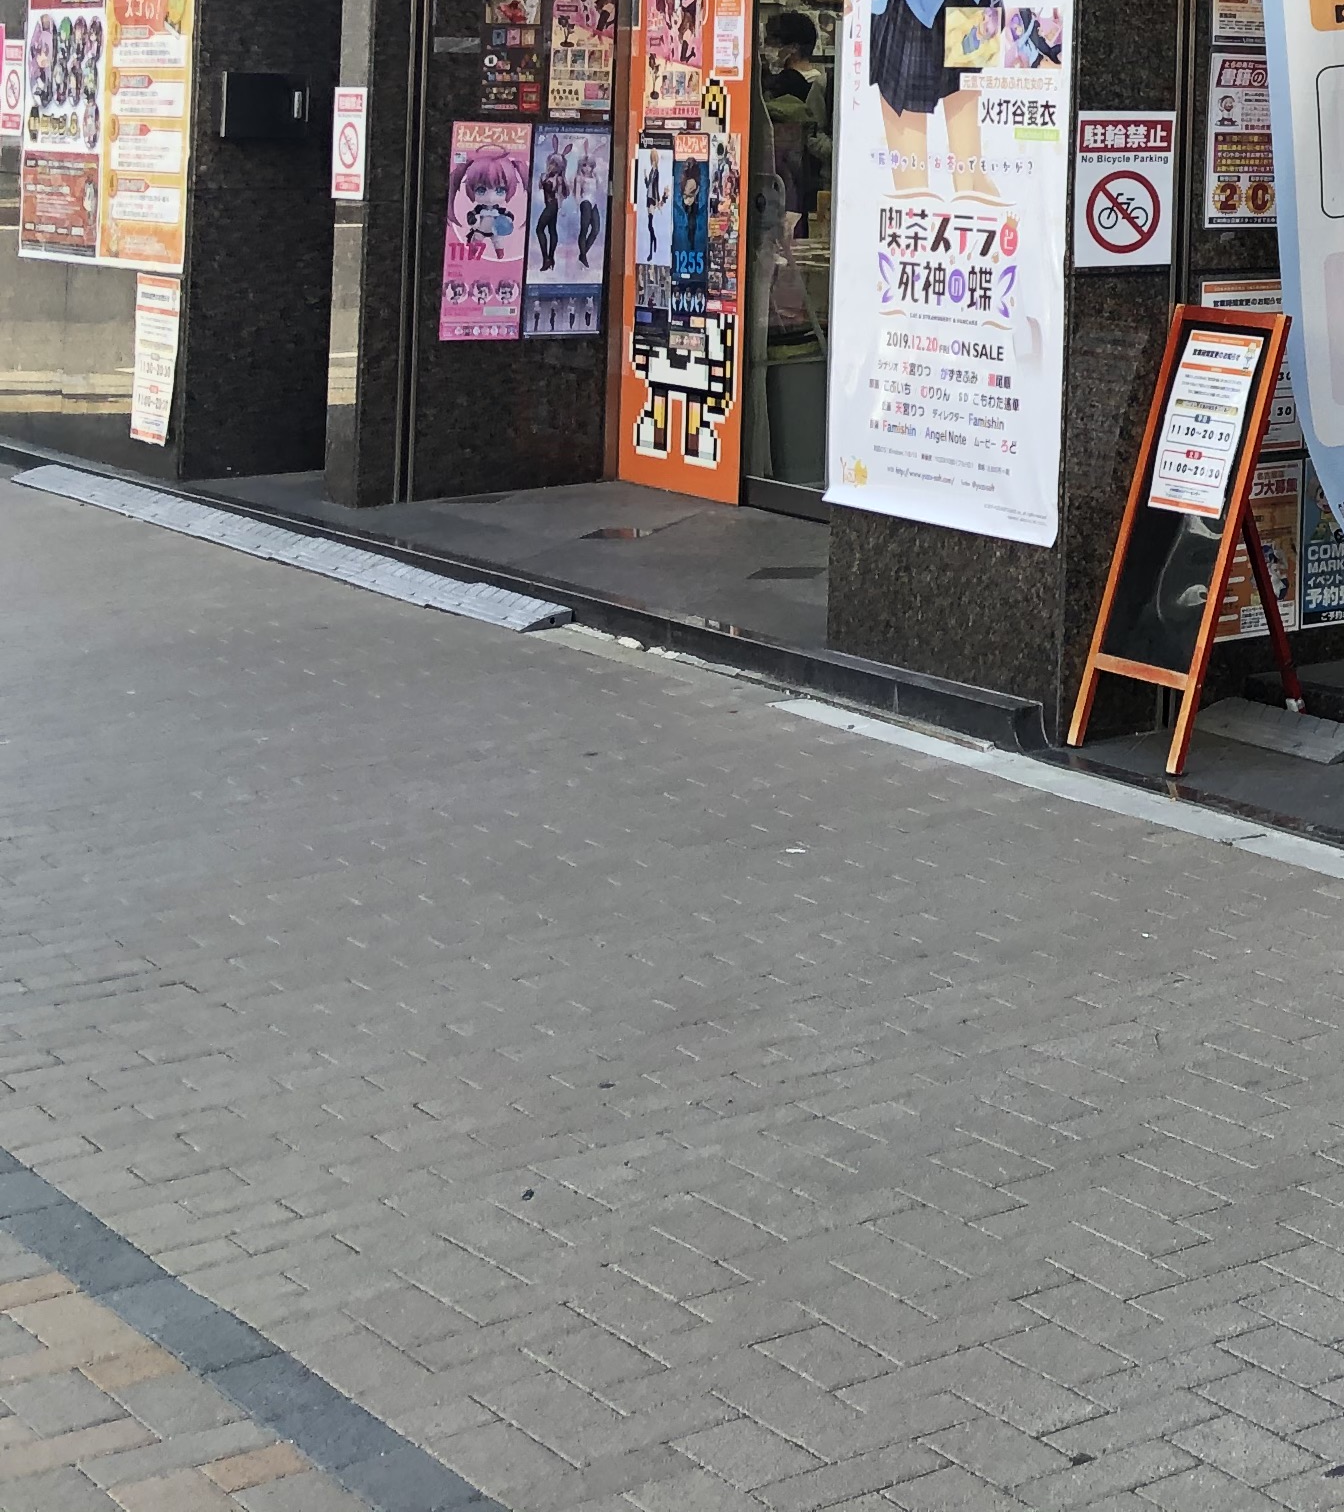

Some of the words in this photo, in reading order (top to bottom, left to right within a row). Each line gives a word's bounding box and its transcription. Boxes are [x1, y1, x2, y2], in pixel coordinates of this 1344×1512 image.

[981, 98, 1057, 127] 火打谷愛衣
[457, 125, 527, 145] ねんどろいど
[1082, 124, 1169, 149] 駐輪禁止
[1081, 155, 1094, 164] No
[1096, 154, 1131, 165] Bicycle
[1133, 154, 1169, 165] Parking
[879, 206, 1020, 257] 喫茶ステラと
[448, 241, 487, 261] 1117
[675, 251, 705, 275] 1255
[897, 260, 994, 312] 死神の蝶
[886, 331, 938, 353] 2019.12.20
[951, 339, 970, 358] ON
[972, 342, 1004, 362] SALE
[882, 419, 917, 437] Famishin
[924, 426, 947, 445] Angel
[947, 429, 967, 447] Note
[968, 413, 1005, 431] Famishin
